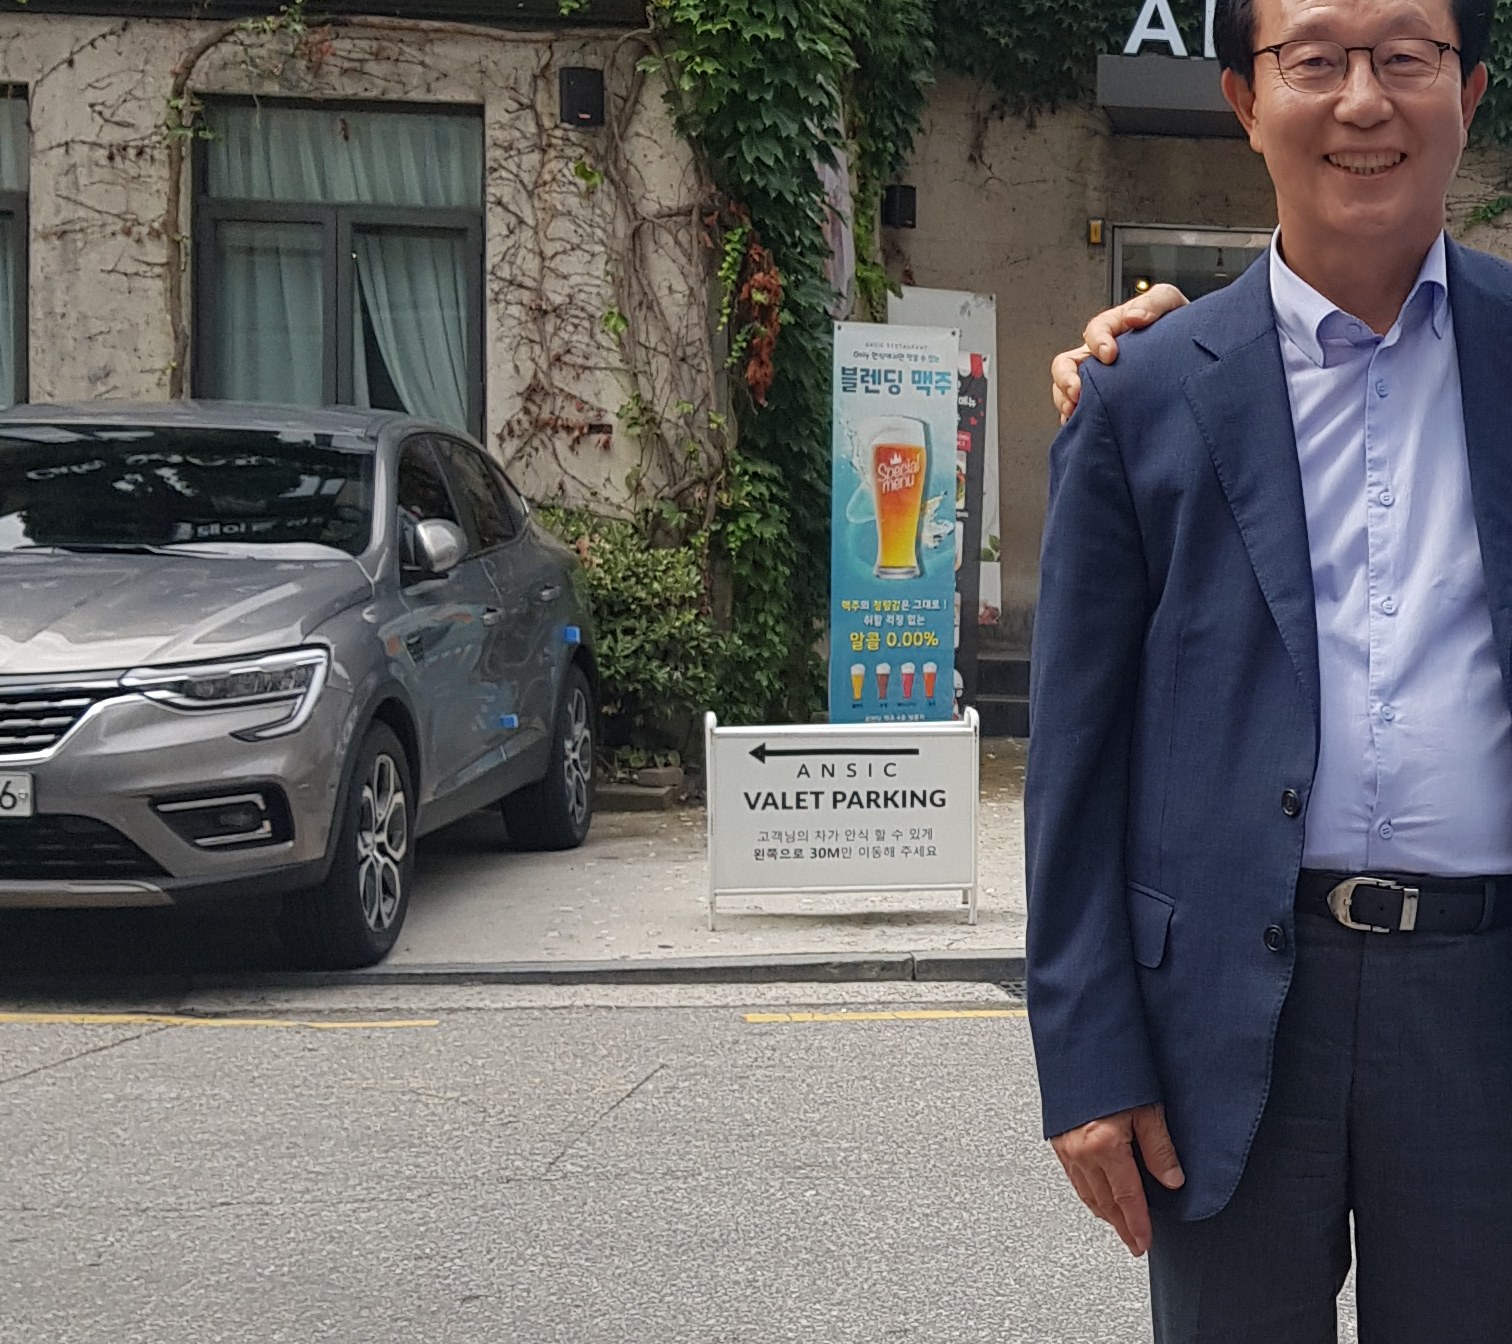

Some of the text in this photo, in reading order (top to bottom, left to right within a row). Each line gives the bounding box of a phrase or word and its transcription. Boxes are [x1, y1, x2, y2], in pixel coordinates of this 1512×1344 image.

[841, 366, 952, 396] 블렌딩 맥주
[877, 453, 920, 484] Special
[881, 471, 915, 494] menu
[886, 631, 940, 648] 0.00%
[796, 762, 897, 778] ANSIC
[744, 789, 947, 810] VALET PARKING
[757, 829, 809, 843] 고객님의
[844, 828, 870, 842] 안식
[874, 828, 886, 842] 할
[891, 828, 903, 841] 수
[909, 827, 934, 841] 있게
[753, 844, 938, 861] 왼쪽으로 30M만 이동해 주세요
